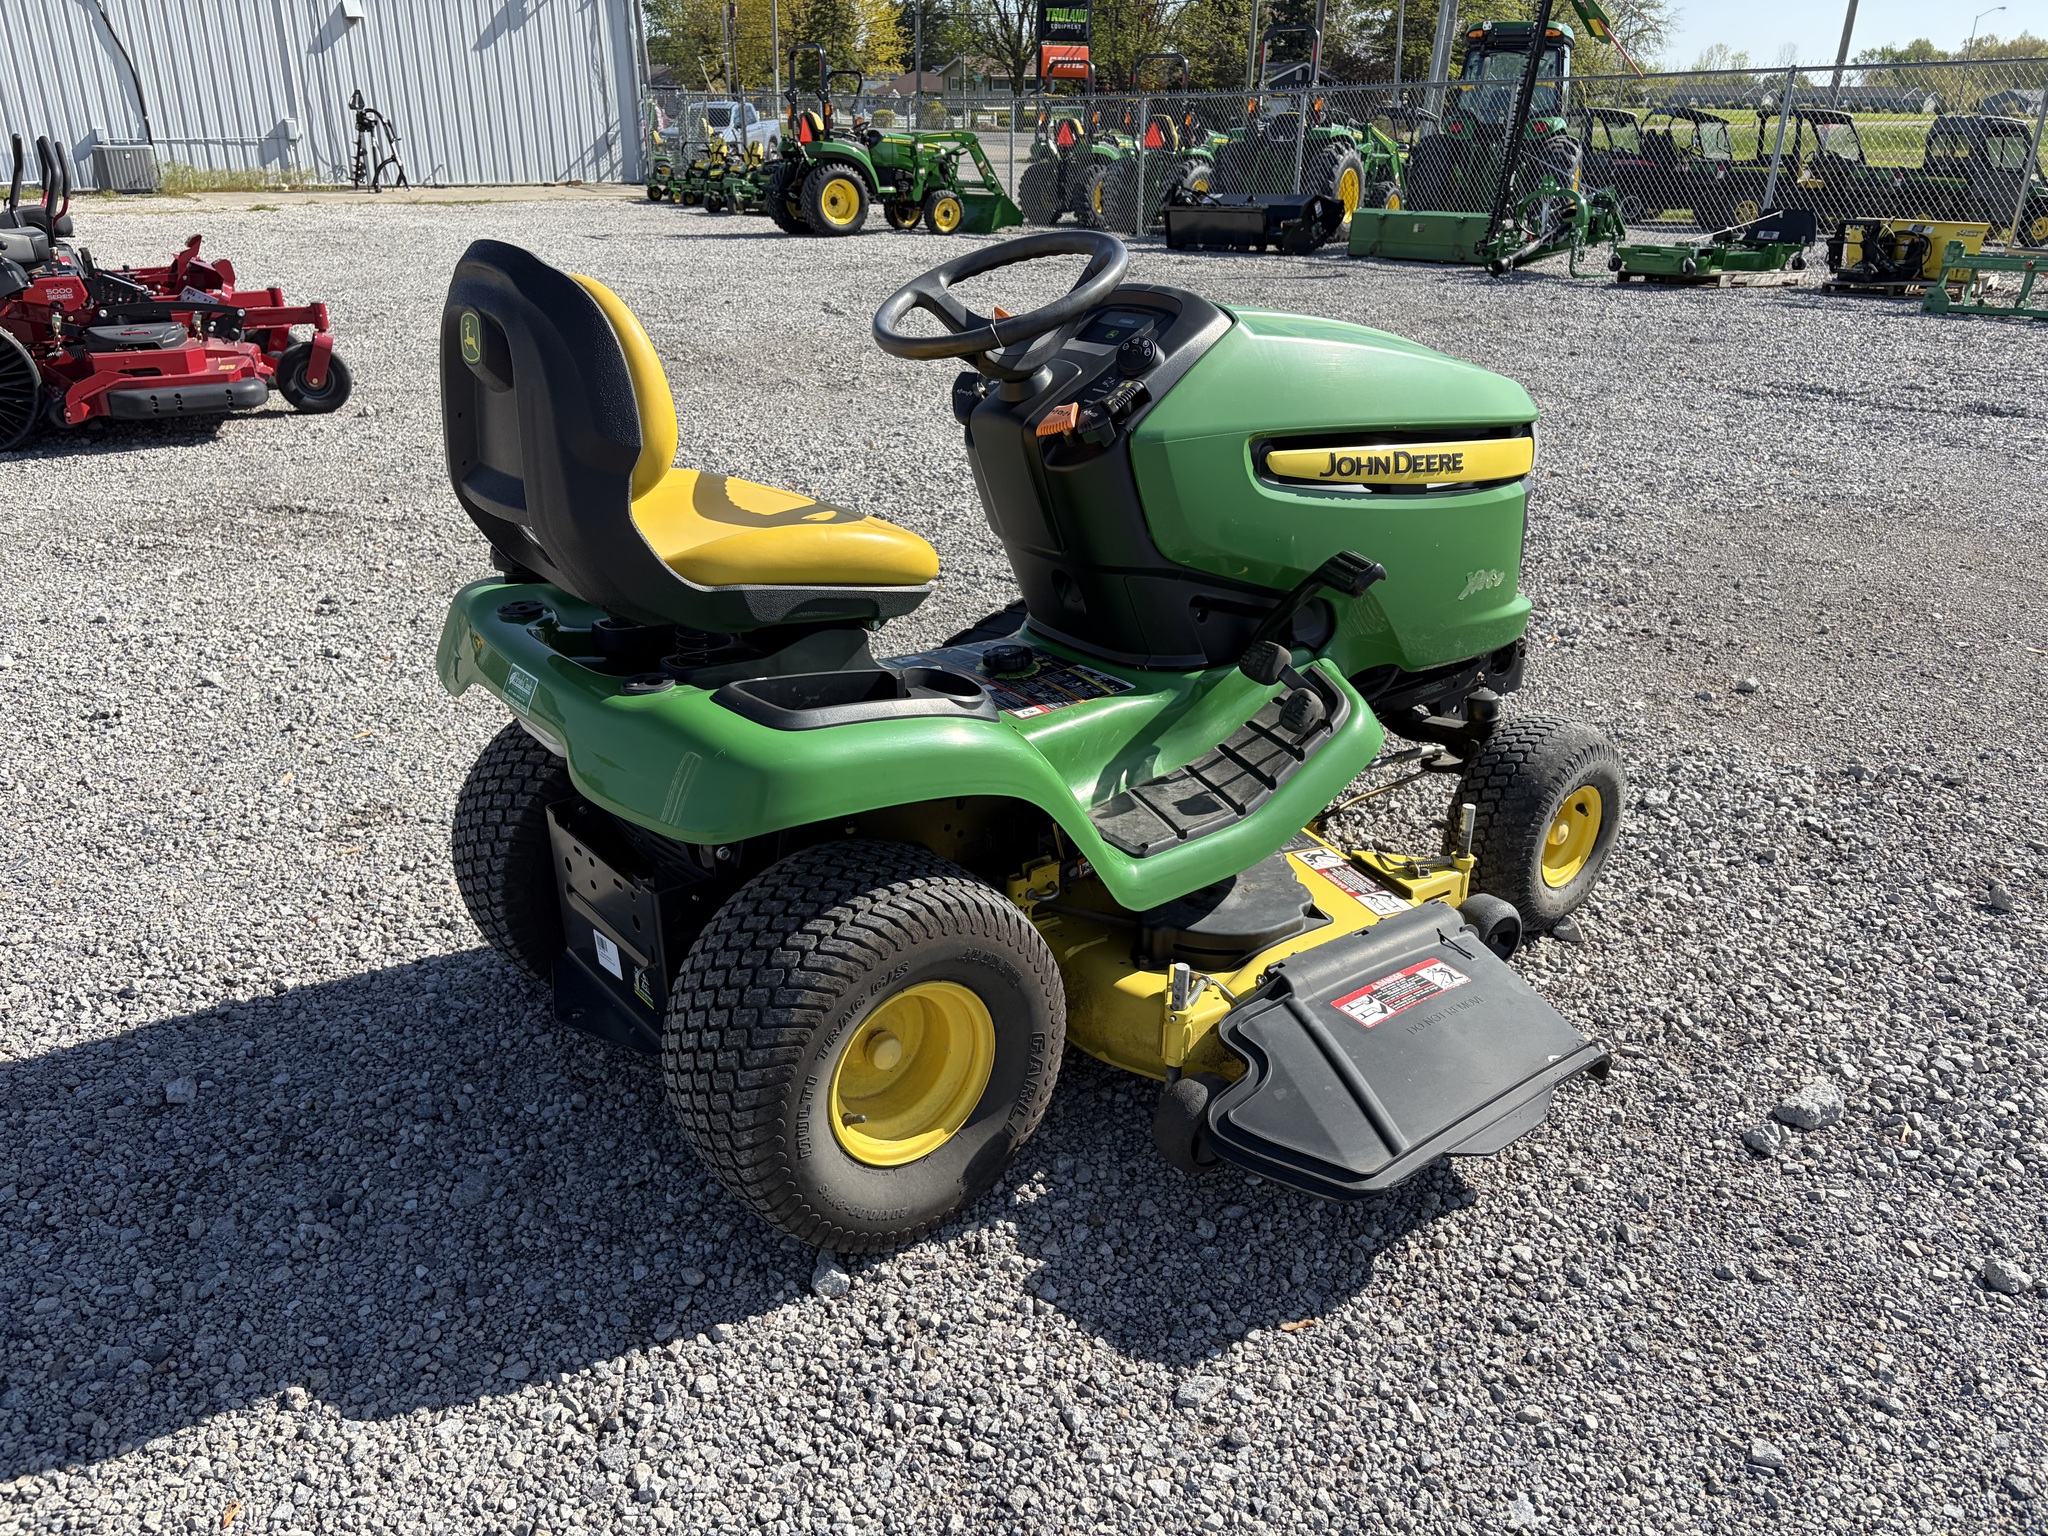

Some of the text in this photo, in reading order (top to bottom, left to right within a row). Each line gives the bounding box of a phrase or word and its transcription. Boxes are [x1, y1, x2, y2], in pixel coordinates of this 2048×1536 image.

[1045, 8, 1087, 23] TRULAND
[1319, 450, 1464, 477] JOHN DEERE
[1377, 972, 1405, 989] DANGER
[1406, 1022, 1423, 1036] DO
[1426, 1012, 1447, 1027] NOT
[794, 1073, 819, 1161] MULTI
[814, 993, 866, 1061] TRAC
